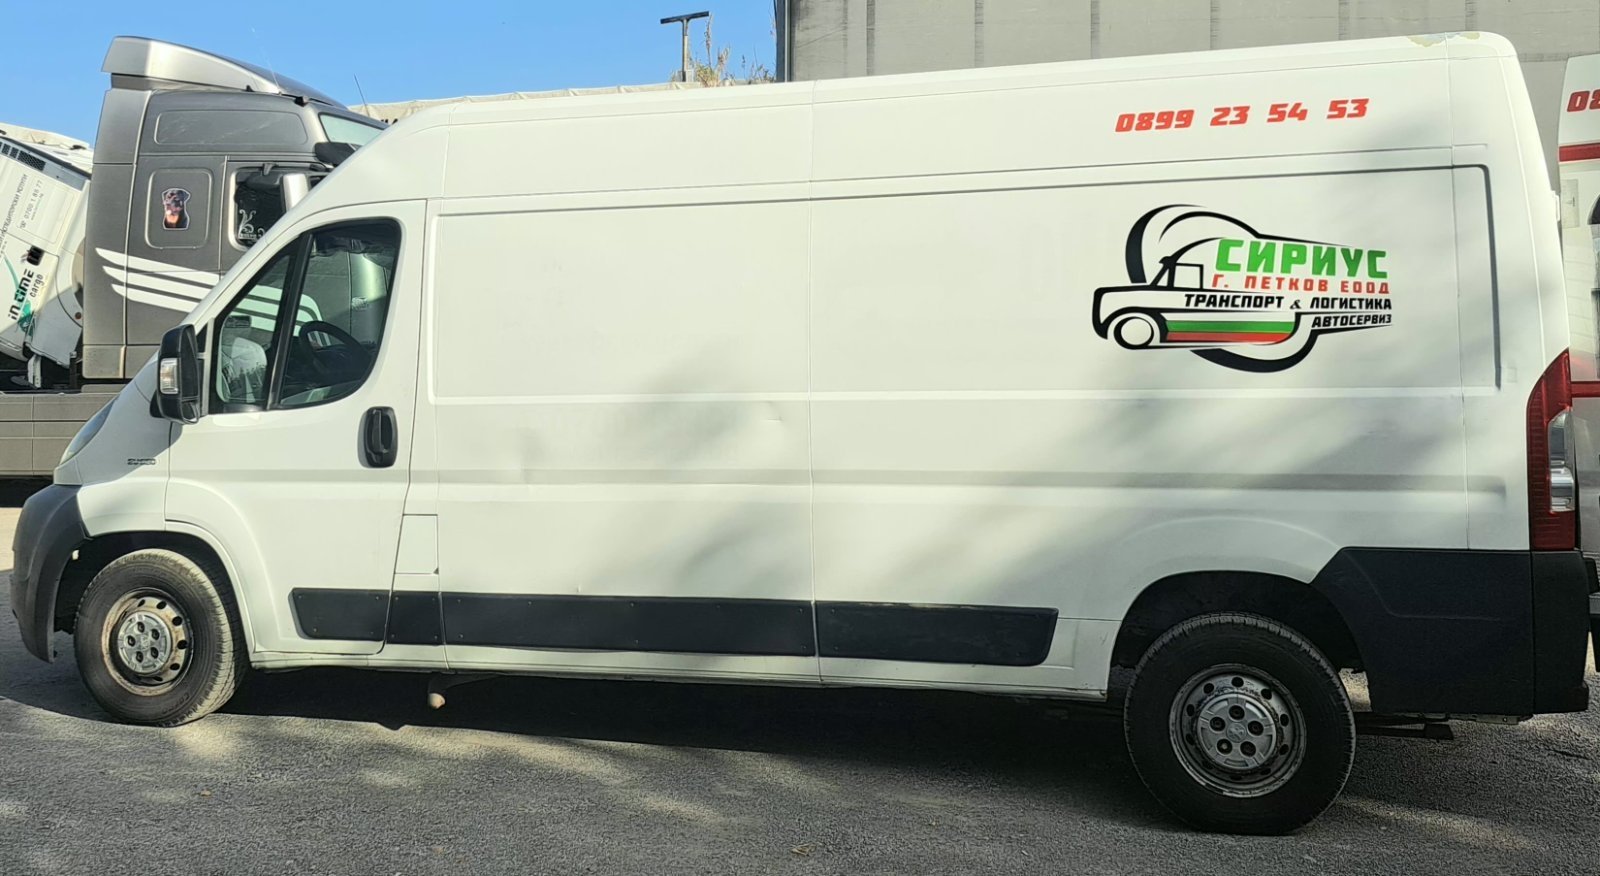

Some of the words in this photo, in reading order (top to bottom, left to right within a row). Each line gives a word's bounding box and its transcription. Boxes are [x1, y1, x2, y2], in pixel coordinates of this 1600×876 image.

[1115, 109, 1195, 133] 0899
[1210, 105, 1251, 127] 23
[1266, 102, 1308, 123] 54
[1326, 98, 1370, 119] 53
[1215, 238, 1388, 279] СИРИУС
[29, 274, 46, 298] cargo
[1212, 274, 1229, 288] Г.
[1244, 275, 1328, 292] ПЕТКОВ
[1340, 280, 1390, 295] ЕООД
[1184, 293, 1285, 308] ТРАНСПОРТ
[1290, 299, 1302, 310] &
[1309, 297, 1392, 310] ЛОГИСТИКА
[1311, 313, 1392, 328] АВТОСЕРВИЗ
